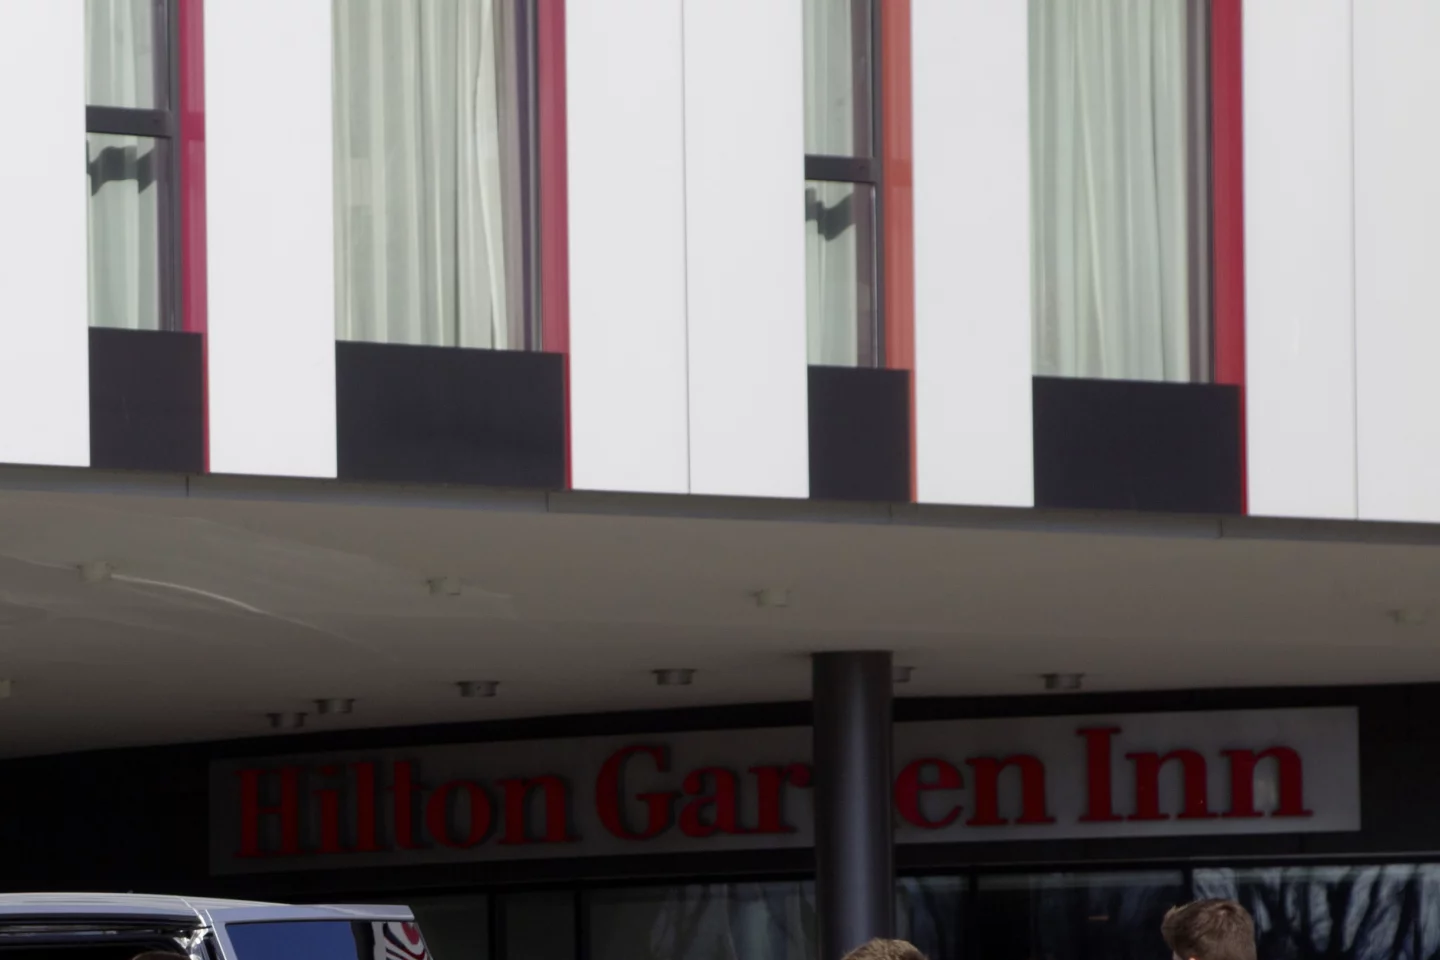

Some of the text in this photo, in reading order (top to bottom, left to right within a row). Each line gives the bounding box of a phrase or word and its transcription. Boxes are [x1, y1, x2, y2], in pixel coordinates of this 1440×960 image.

[232, 726, 1314, 858] Hilton Garen Inn
